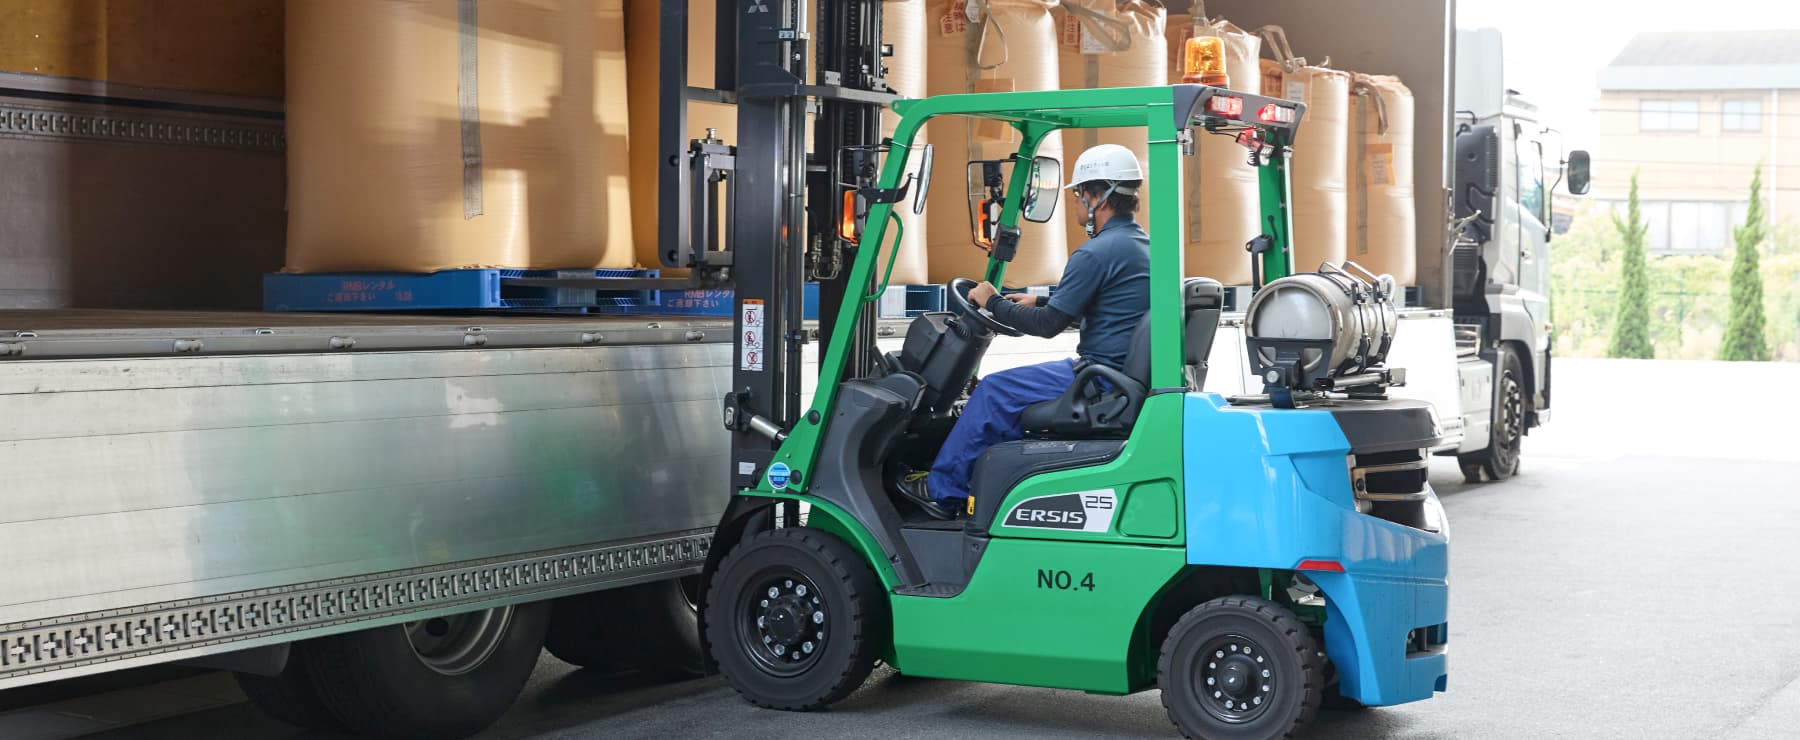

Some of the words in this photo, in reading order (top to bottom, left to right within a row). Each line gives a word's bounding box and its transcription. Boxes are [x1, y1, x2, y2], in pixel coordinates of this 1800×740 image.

[1015, 508, 1084, 524] ERSIS
[1085, 495, 1113, 509] 25
[1037, 568, 1096, 592] NO.4
